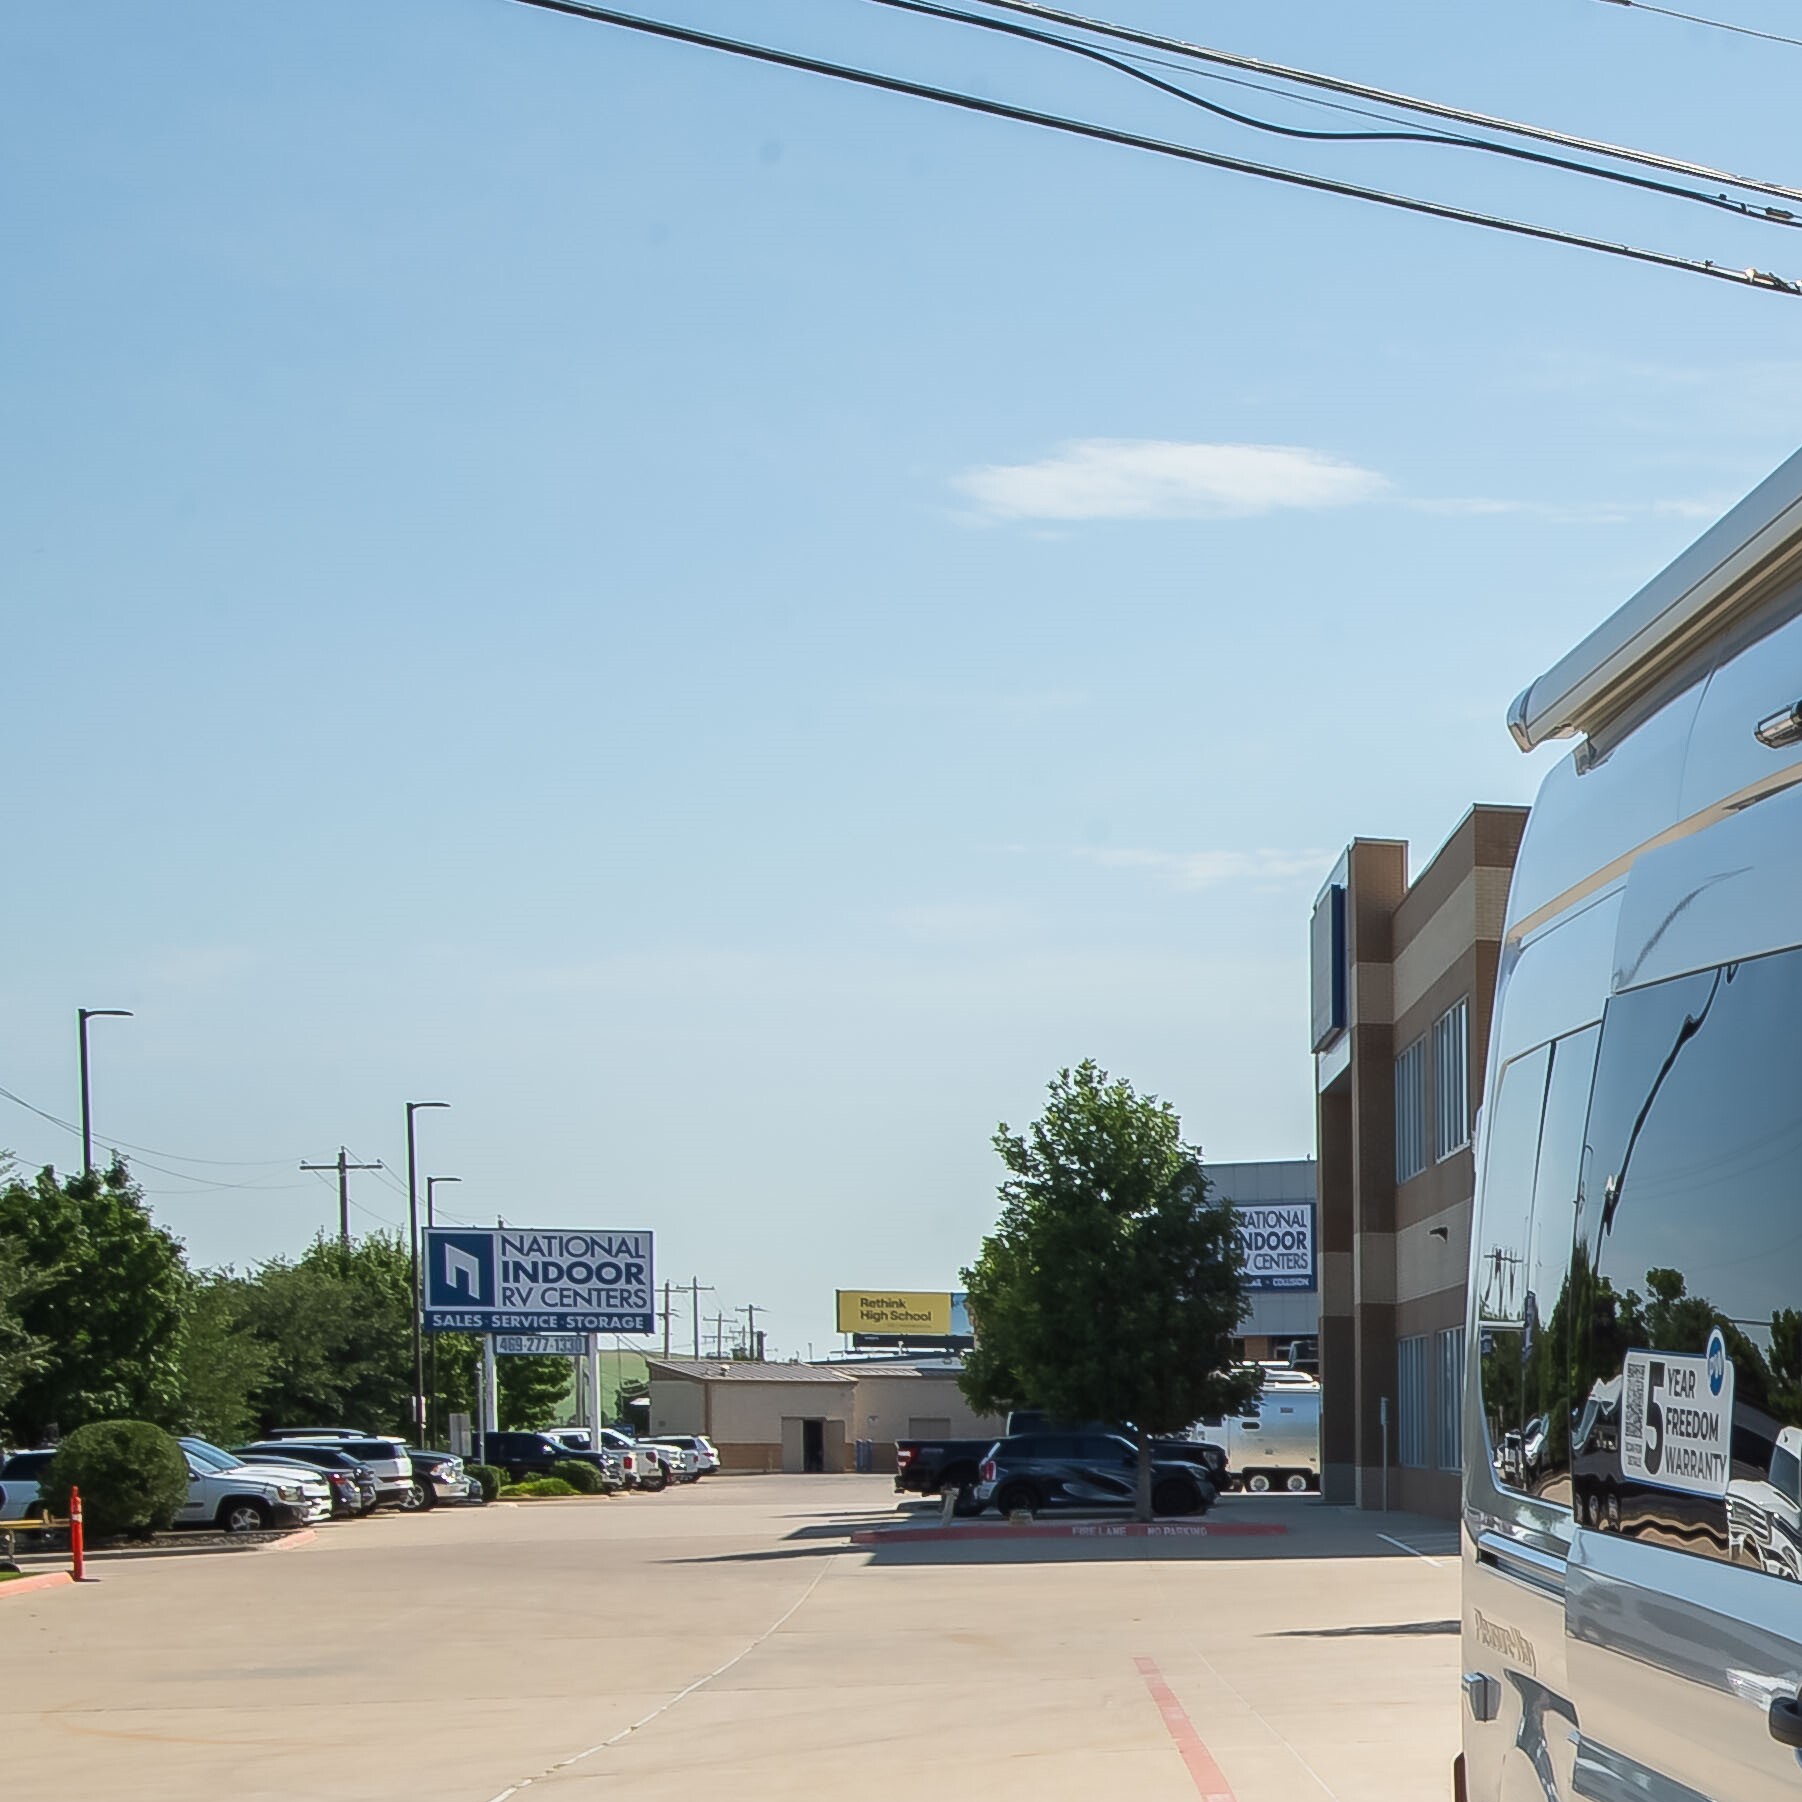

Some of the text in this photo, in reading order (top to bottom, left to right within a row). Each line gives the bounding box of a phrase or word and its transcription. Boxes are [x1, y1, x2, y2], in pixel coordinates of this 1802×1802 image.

[1240, 1210, 1307, 1229] ATIONAL
[501, 1235, 646, 1259] NATIONAL
[1240, 1231, 1307, 1251] NDOOR
[1254, 1253, 1309, 1270] CENTERS
[502, 1260, 646, 1286] INDOOR
[502, 1287, 647, 1309] RV CENTERS
[860, 1298, 906, 1309] Rethink
[433, 1314, 643, 1330] SALES SERVICE STORAGE
[860, 1311, 932, 1323] High School
[1667, 1368, 1696, 1399] YEAR
[1644, 1361, 1666, 1475] 5
[1665, 1407, 1719, 1442] FREEDOM
[1664, 1445, 1727, 1483] WARRANTY
[1099, 1526, 1127, 1536] LANE
